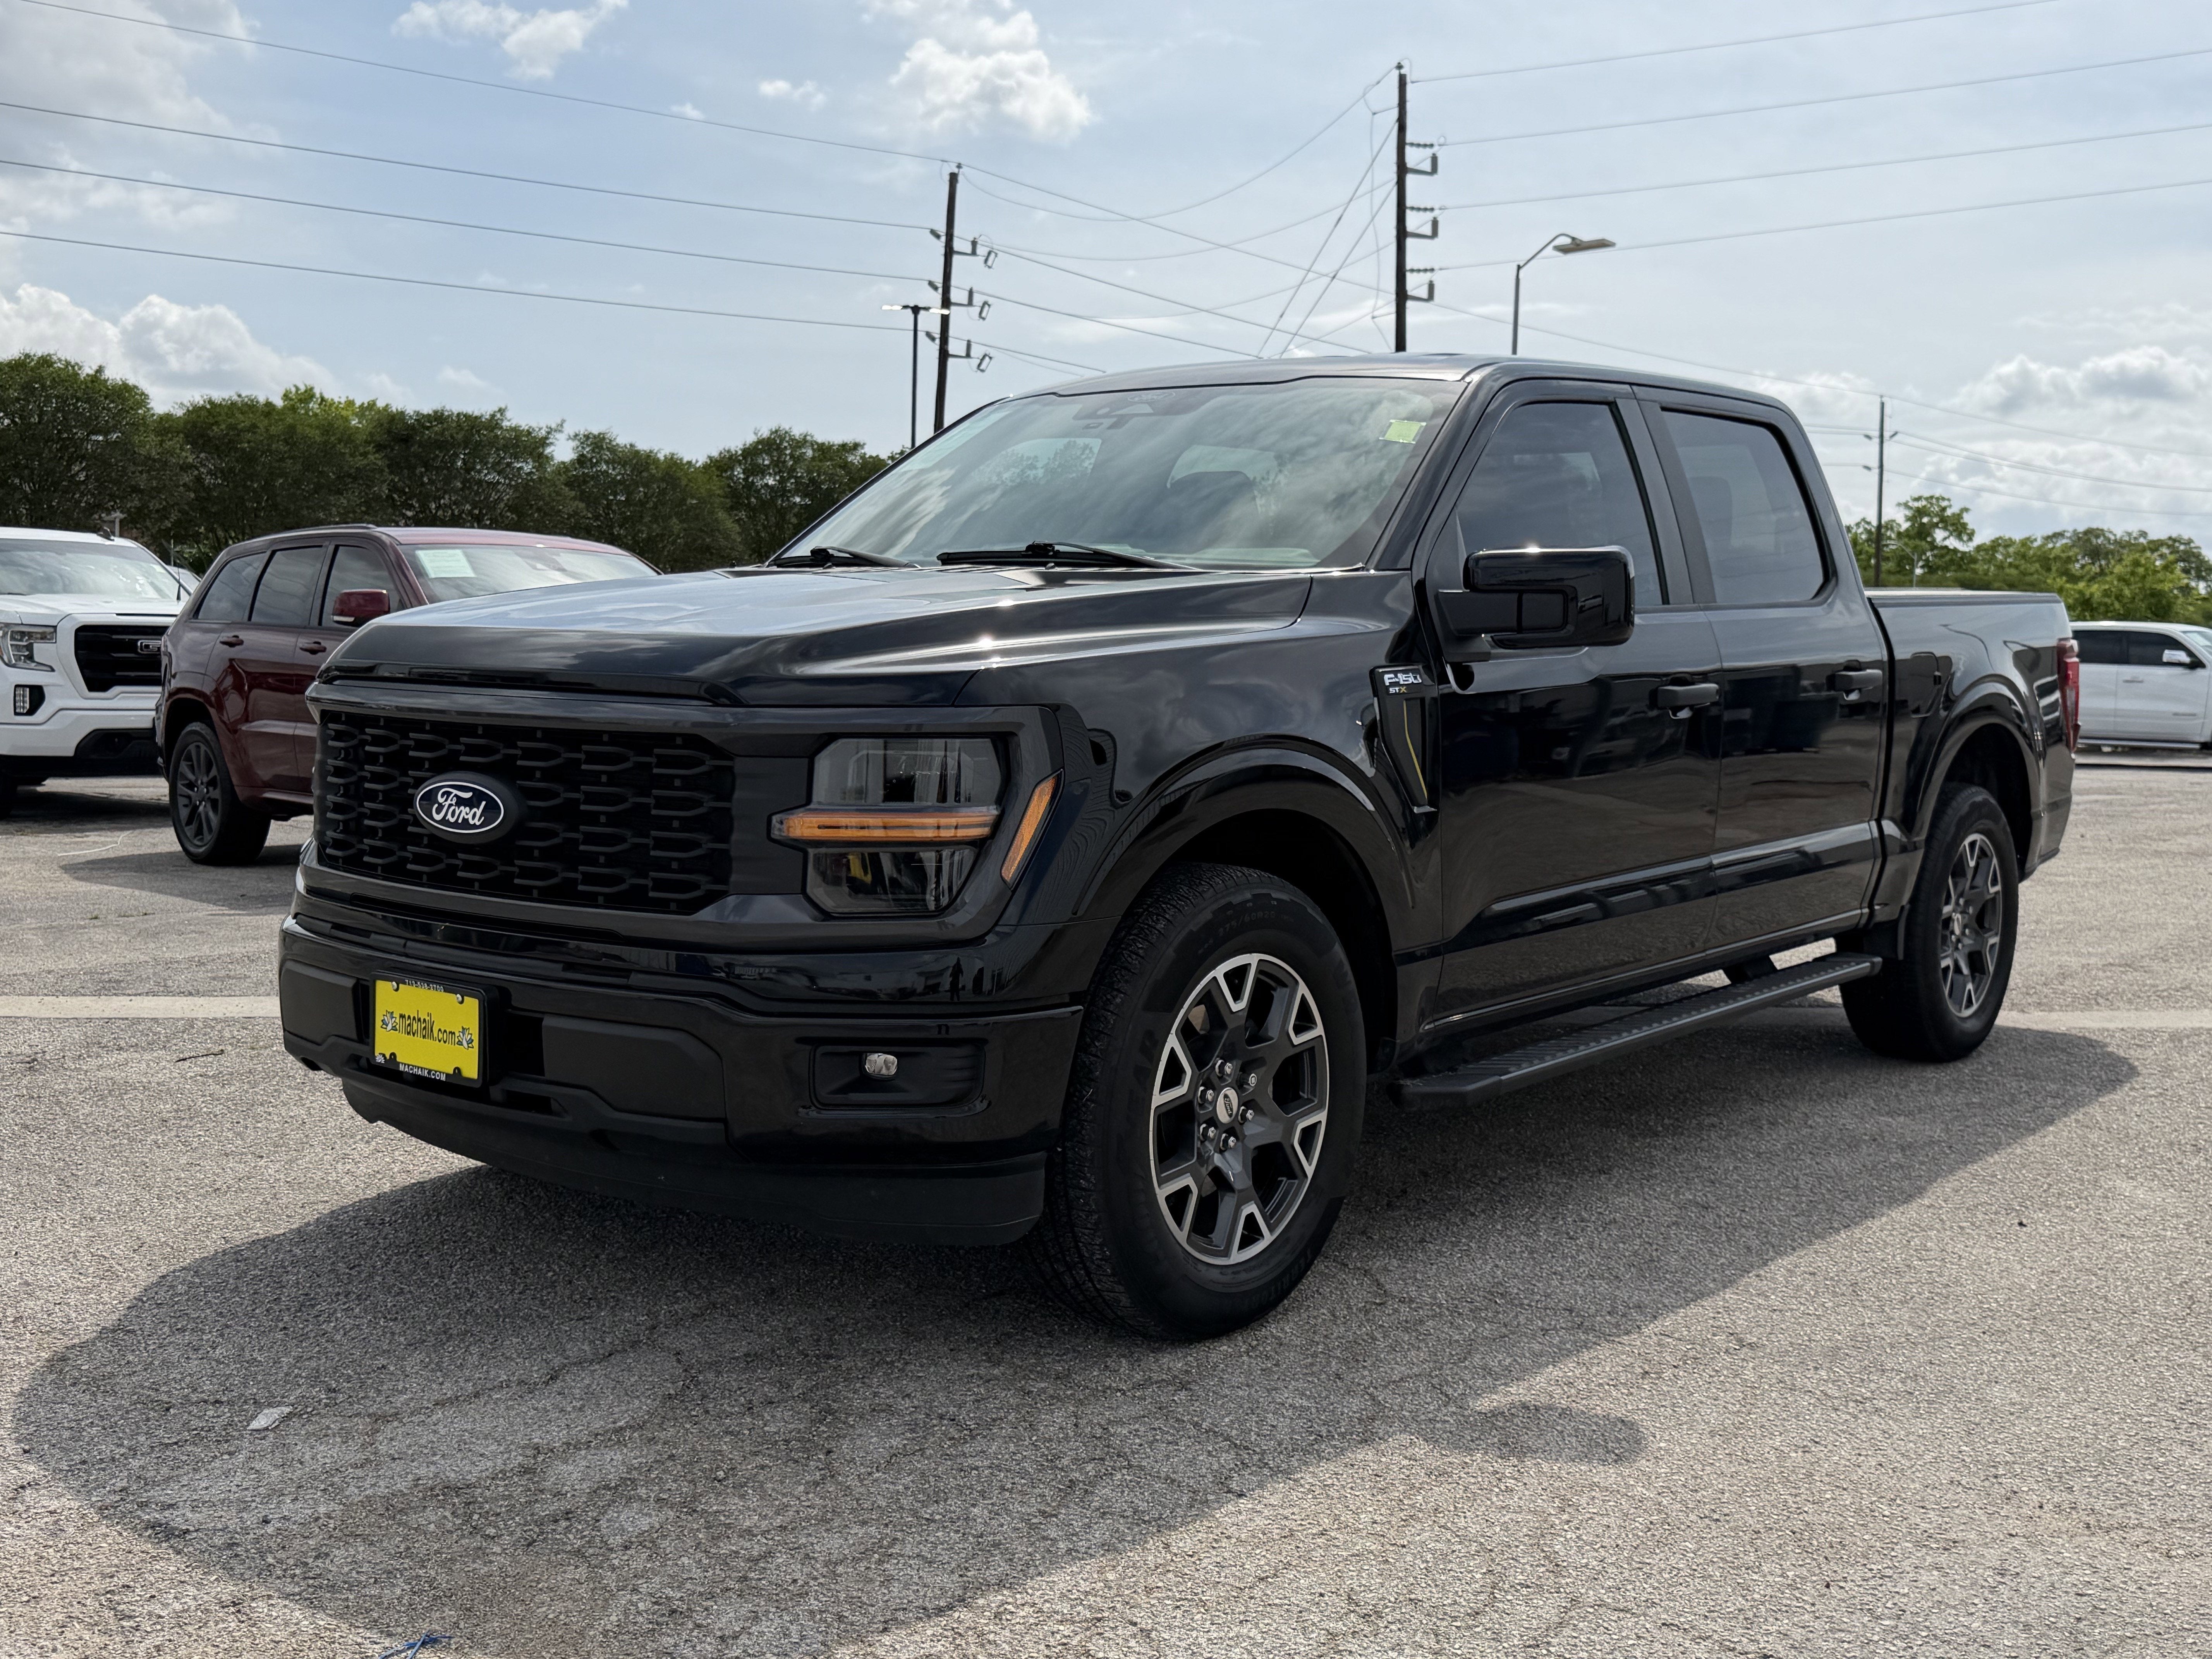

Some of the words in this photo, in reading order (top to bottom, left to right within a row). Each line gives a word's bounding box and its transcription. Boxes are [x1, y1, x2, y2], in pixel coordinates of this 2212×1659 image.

[1384, 673, 1422, 686] F-150
[432, 787, 486, 826] Ford
[398, 1009, 456, 1046] machaik.com
[399, 1063, 446, 1081] MACHAIK.COM
